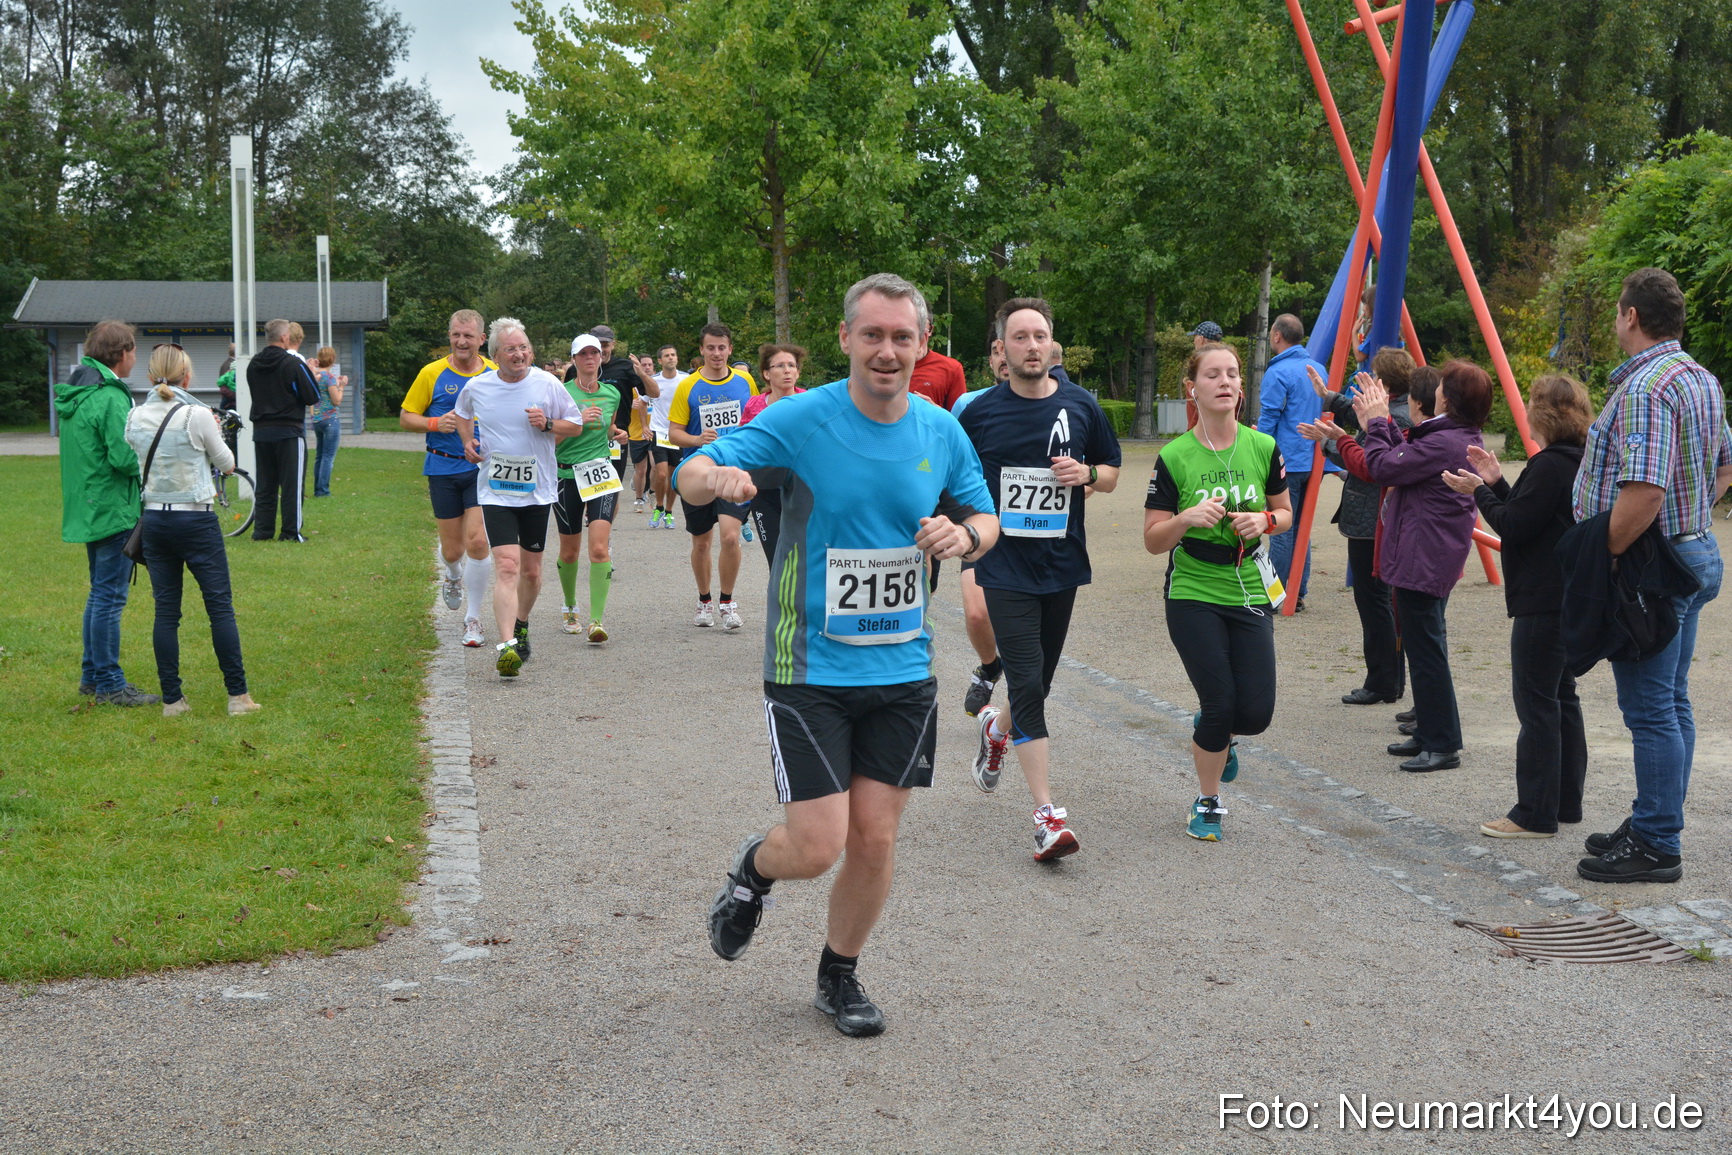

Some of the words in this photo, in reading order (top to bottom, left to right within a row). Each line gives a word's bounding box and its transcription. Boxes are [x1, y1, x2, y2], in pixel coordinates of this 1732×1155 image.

[705, 410, 738, 428] 3385
[492, 464, 532, 481] 2715
[583, 465, 610, 485] 185
[1002, 473, 1027, 482] PARTL
[1201, 470, 1245, 486] FÜRTH
[500, 482, 524, 490] Herbert
[594, 485, 608, 493] Anke
[1008, 484, 1066, 511] 2725
[1024, 517, 1048, 529] Ryan
[830, 558, 866, 568] PARTL
[868, 556, 913, 568] Neumarkt
[838, 569, 917, 609] 2158
[857, 618, 899, 632] Stefan
